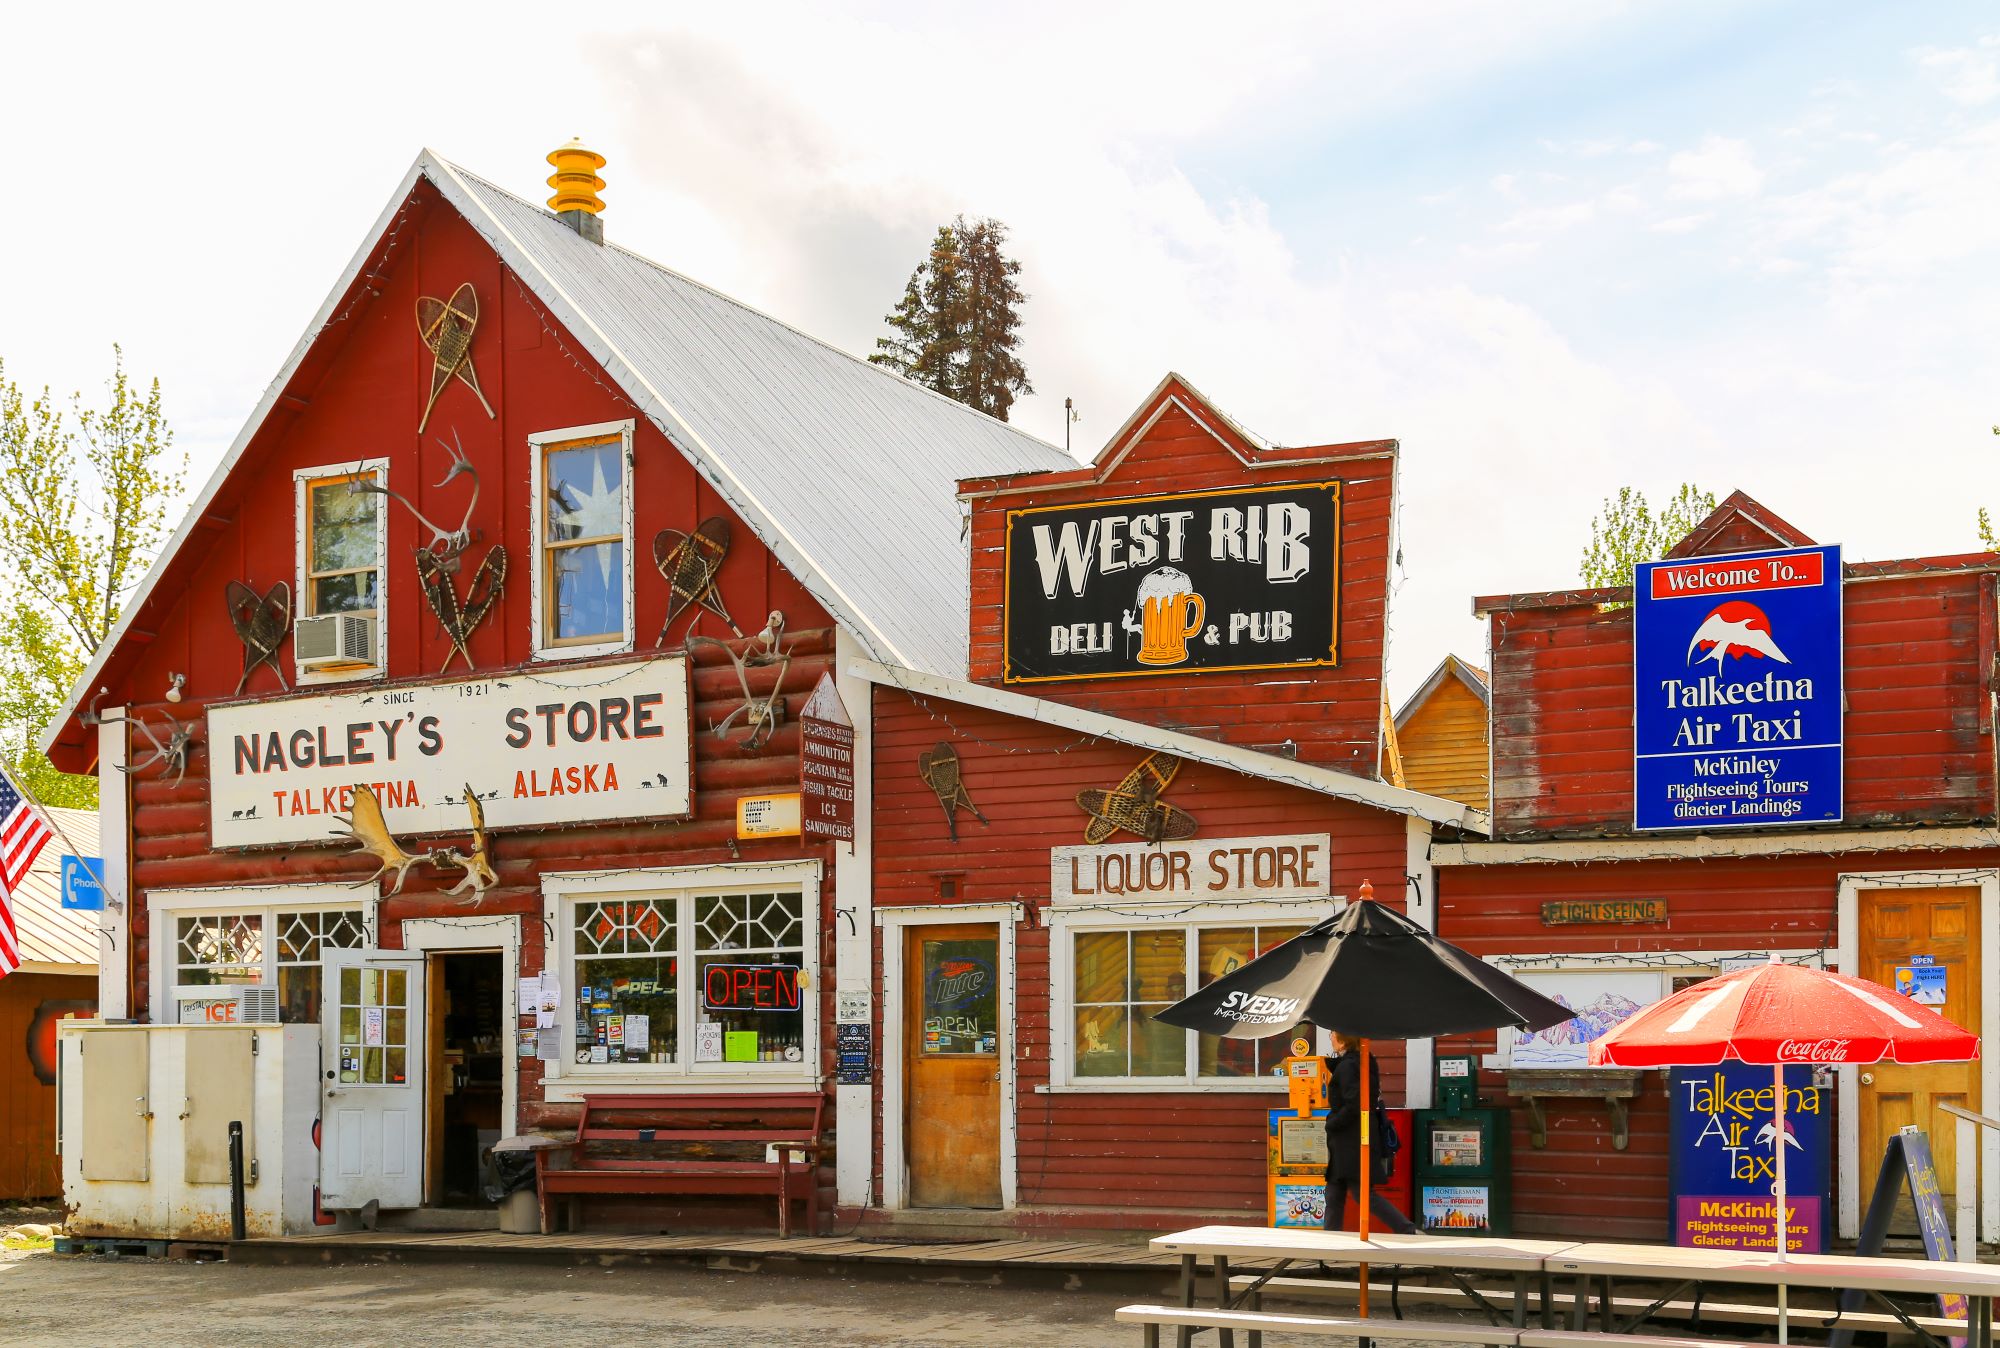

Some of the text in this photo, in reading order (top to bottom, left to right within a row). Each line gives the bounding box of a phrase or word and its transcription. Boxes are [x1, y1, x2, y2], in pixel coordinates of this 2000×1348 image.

[1032, 502, 1311, 600] WEST RIB
[1667, 561, 1807, 591] Welcome To...
[1050, 610, 1293, 656] DELI & PUB
[459, 684, 488, 698] 1921
[1661, 671, 1813, 709] Talkeetna
[233, 692, 664, 776] NAGLEY'S STORE
[1673, 710, 1802, 747] Air Taxi
[804, 741, 851, 763] AMMUNITION
[1693, 755, 1781, 779] McKinley
[273, 762, 619, 817] TALKETNA, ALASKA
[826, 785, 853, 801] TACKLE
[1666, 778, 1809, 802] Flightseeing Tours
[821, 802, 837, 817] ICE
[1674, 797, 1802, 819] Glacier Landings
[805, 819, 852, 838] SANDWICHES
[1071, 845, 1320, 896] LIQUOR STORE
[596, 904, 659, 941] ATM
[1912, 957, 1933, 965] OPEN
[707, 968, 797, 1007] OPEN
[184, 1000, 206, 1012] CRYSTAL
[205, 1002, 237, 1023] ICE
[1221, 991, 1300, 1015] SVEDKA
[932, 1016, 978, 1033] OPEN
[1213, 1007, 1265, 1024] IMPORTED
[1776, 1039, 1852, 1062] Coca-Cola
[1681, 1072, 1820, 1120] Talkeena
[1694, 1112, 1749, 1147] Air
[1722, 1146, 1778, 1184] Tax
[1687, 1221, 1767, 1236] Flightseeing
[1692, 1235, 1803, 1250] Glacier Landigs
